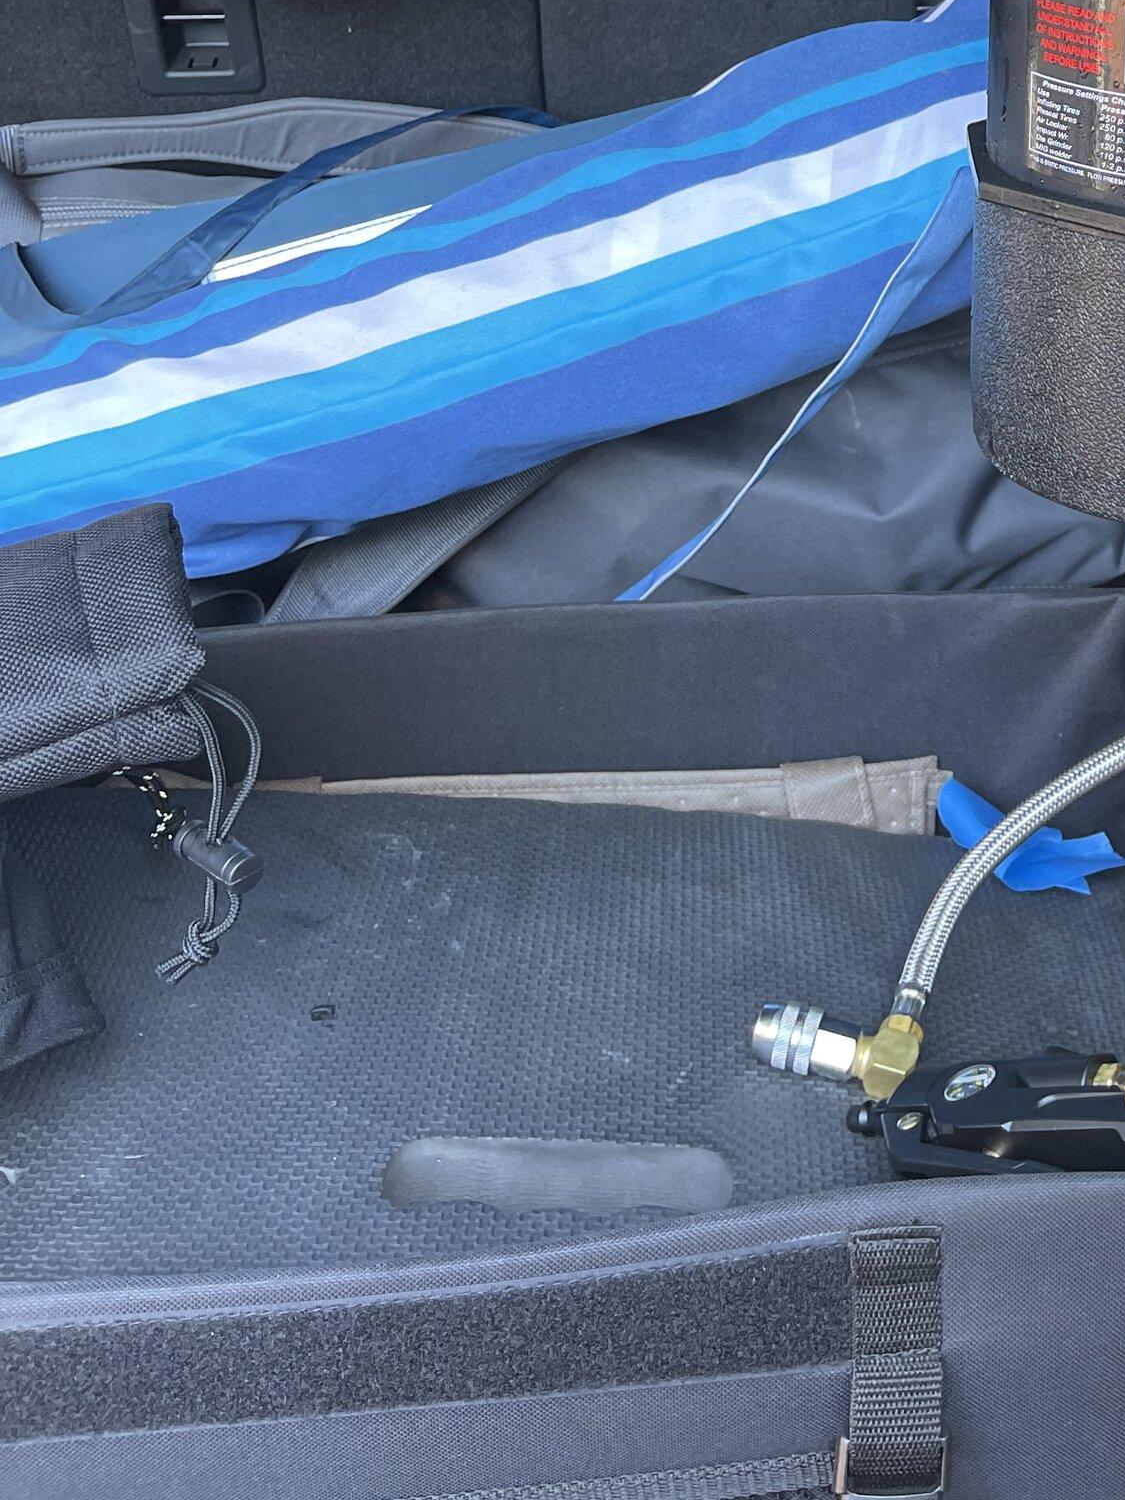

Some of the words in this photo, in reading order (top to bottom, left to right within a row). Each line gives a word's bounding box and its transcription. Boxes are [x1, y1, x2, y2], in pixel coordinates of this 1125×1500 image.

[1037, 88, 1051, 98] Use
[1042, 80, 1074, 95] Pressure
[1075, 89, 1110, 104] Settings
[1062, 104, 1081, 116] Tires
[1099, 114, 1117, 123] 250
[1060, 113, 1078, 125] Tires
[1099, 123, 1116, 133] 250
[1104, 133, 1116, 142] 80
[1099, 142, 1115, 151] 120
[1099, 151, 1115, 161] 110
[1101, 161, 1115, 171] 1-2
